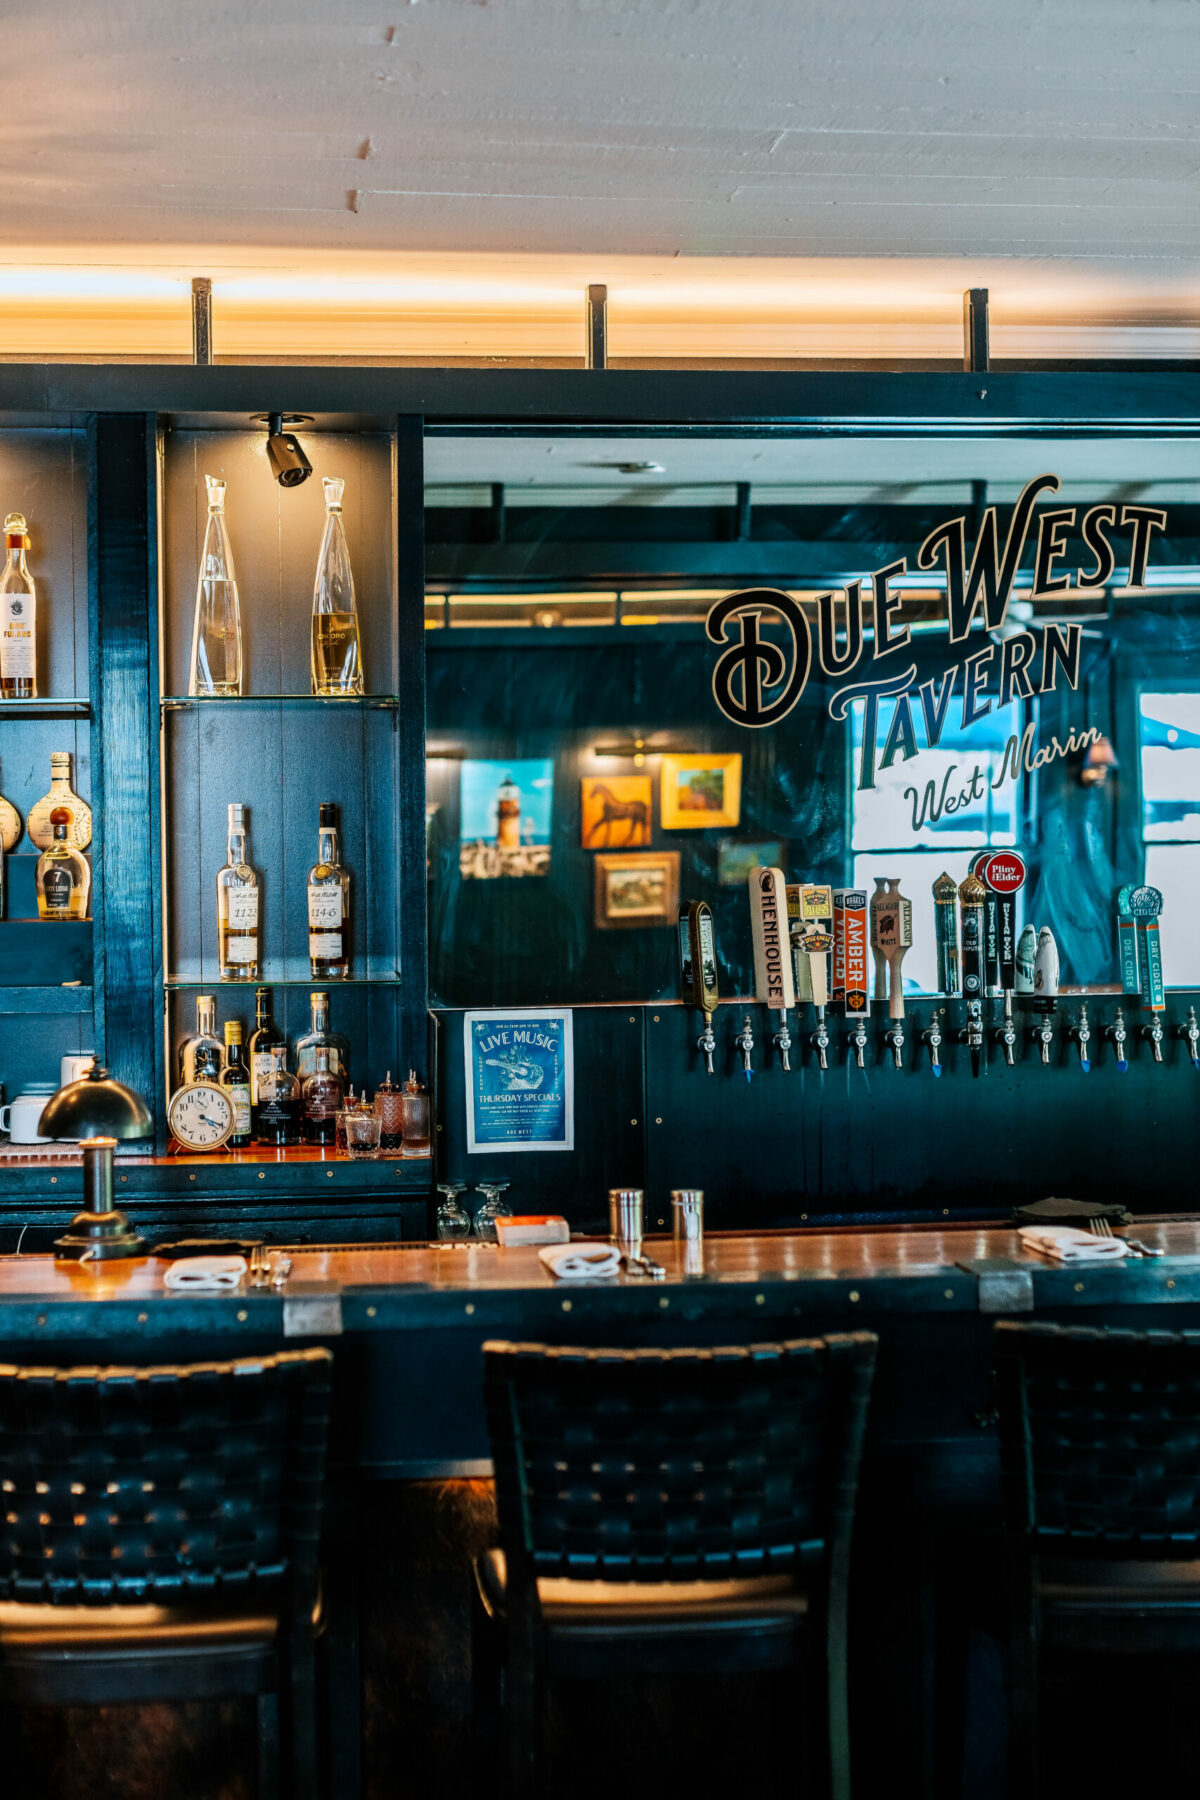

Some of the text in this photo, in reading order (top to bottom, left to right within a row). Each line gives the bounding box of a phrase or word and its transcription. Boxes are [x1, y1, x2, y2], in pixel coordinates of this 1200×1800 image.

[829, 623, 1083, 791] TAVERN
[903, 721, 1102, 832] West Marin
[991, 864, 1017, 874] Pliny
[53, 871, 62, 883] 7
[996, 873, 1022, 882] Elder
[761, 895, 783, 998] HENHOUSE
[848, 917, 863, 982] AMBER
[1151, 940, 1162, 991] DRY CIDER
[480, 1030, 559, 1053] LIVE MUSIC
[187, 1095, 194, 1103] 11
[478, 1093, 561, 1103] THURSDAY SPECIALS
[180, 1103, 188, 1111] 10
[181, 1124, 187, 1132] 8
[188, 1130, 195, 1139] 7
[200, 1134, 206, 1142] 6
